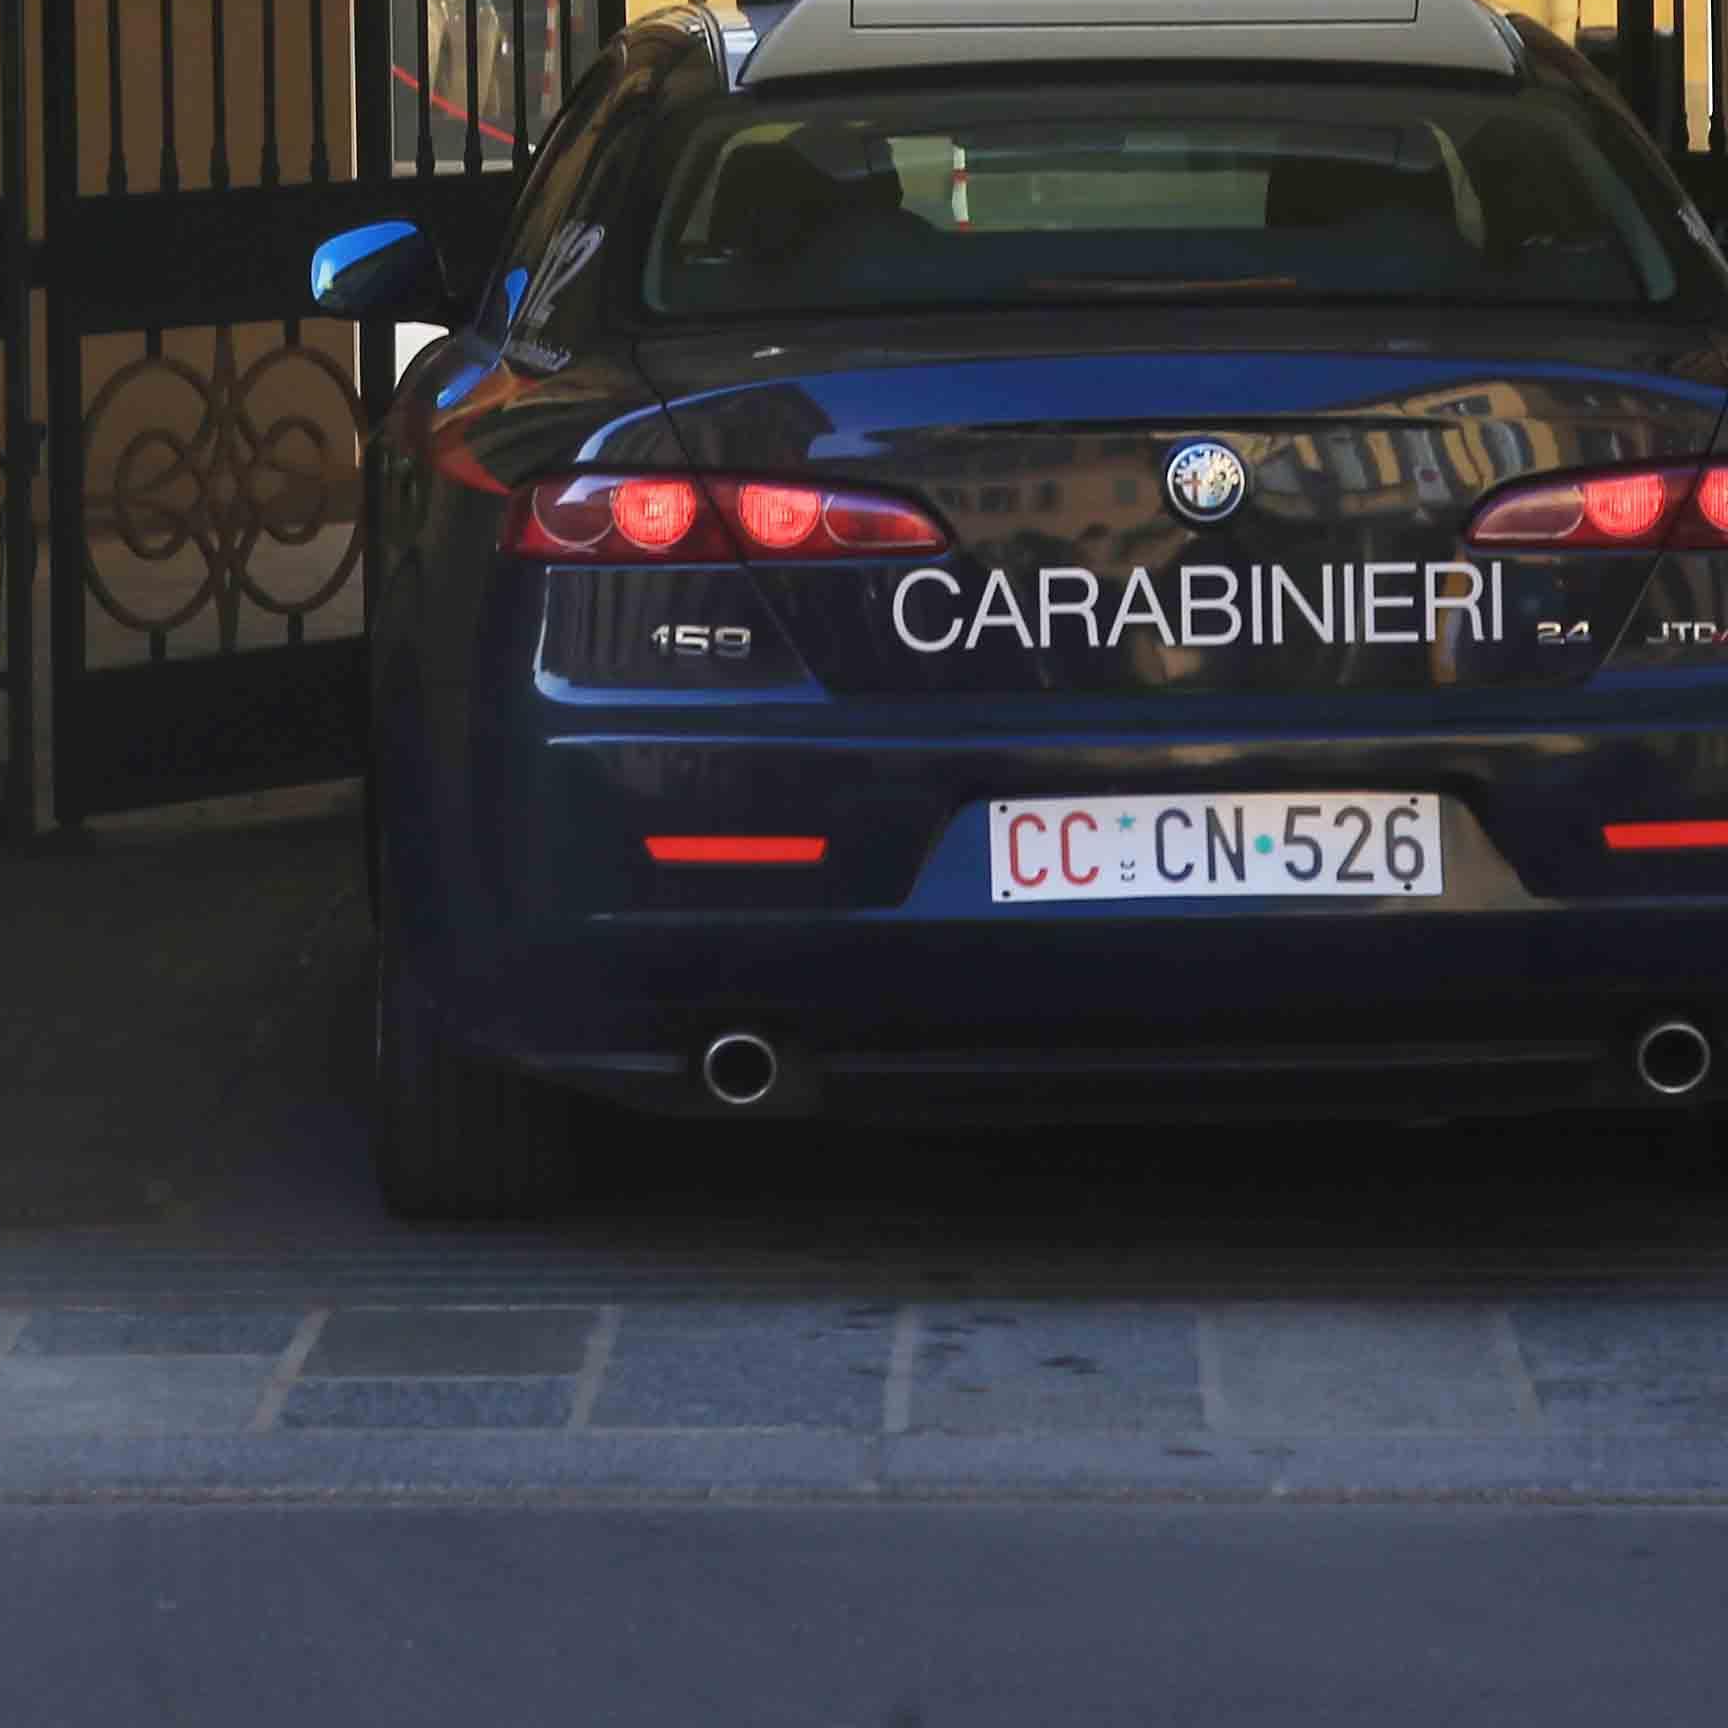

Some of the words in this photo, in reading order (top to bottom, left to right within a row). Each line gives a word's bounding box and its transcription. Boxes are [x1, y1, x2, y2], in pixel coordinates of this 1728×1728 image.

[650, 624, 751, 658] 159
[892, 560, 1503, 653] CARABINIERI
[1008, 810, 1099, 888] CC
[1154, 805, 1247, 884] CN
[1282, 803, 1426, 883] 526
